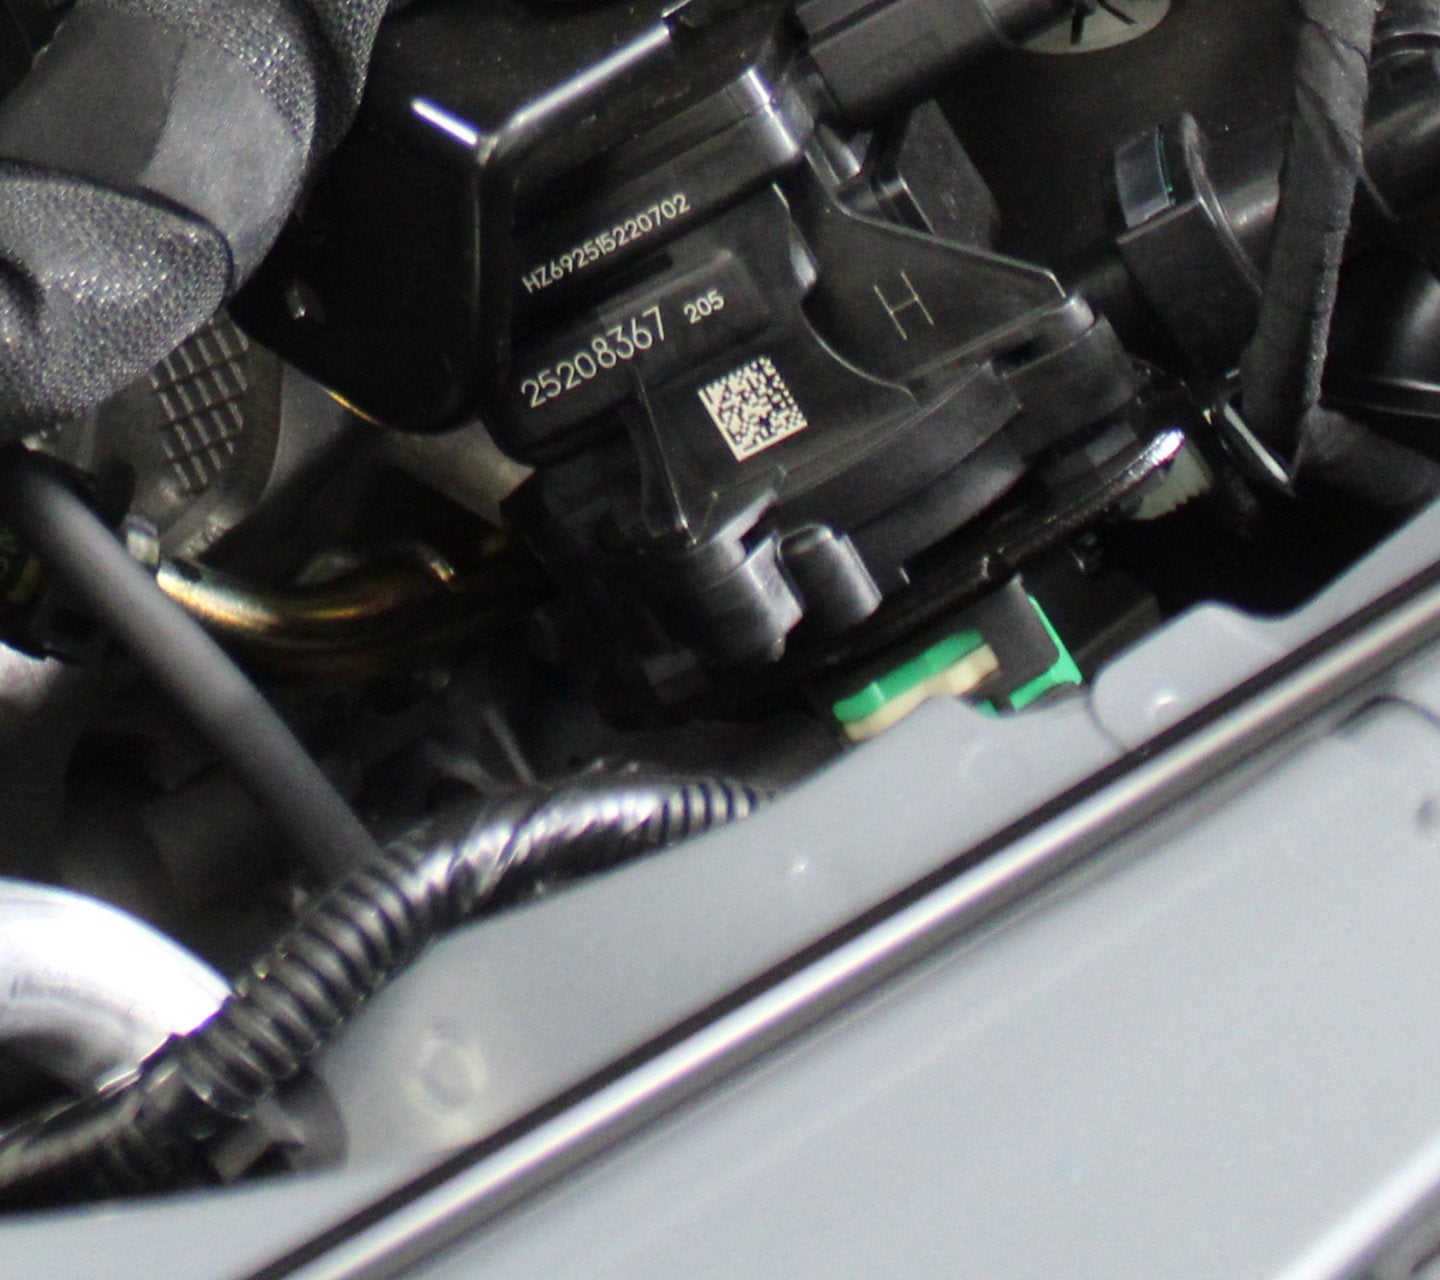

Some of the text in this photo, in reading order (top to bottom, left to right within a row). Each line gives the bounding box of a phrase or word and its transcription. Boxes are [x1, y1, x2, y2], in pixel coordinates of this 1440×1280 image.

[521, 193, 691, 294] HZ692515220702
[520, 289, 725, 409] 25208367 205
